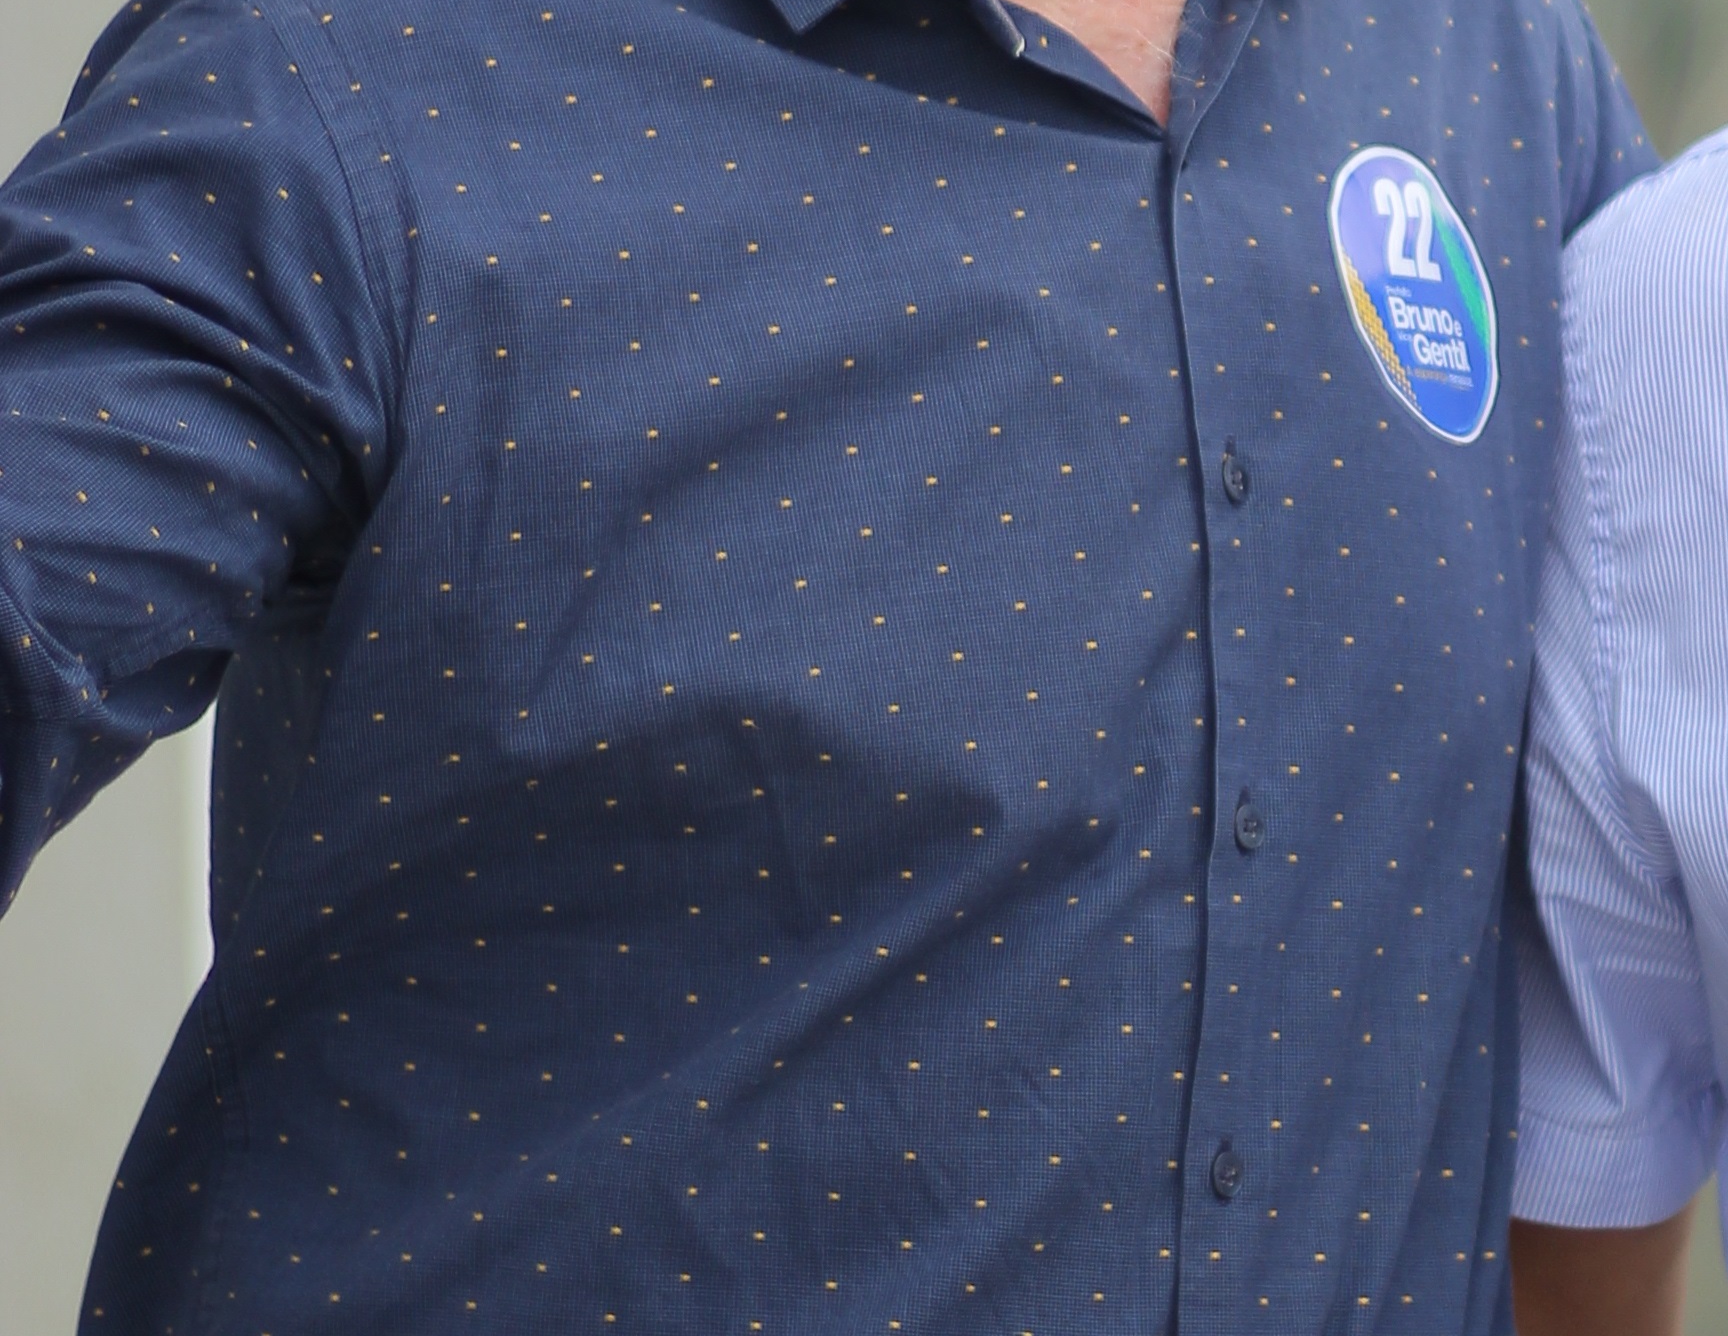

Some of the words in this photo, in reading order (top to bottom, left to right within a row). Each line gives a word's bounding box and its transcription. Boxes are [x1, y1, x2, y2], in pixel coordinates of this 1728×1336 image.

[1373, 178, 1443, 282] 22
[1388, 296, 1453, 336] Bruno
[1453, 320, 1462, 337] e
[1413, 333, 1471, 372] Gentil
